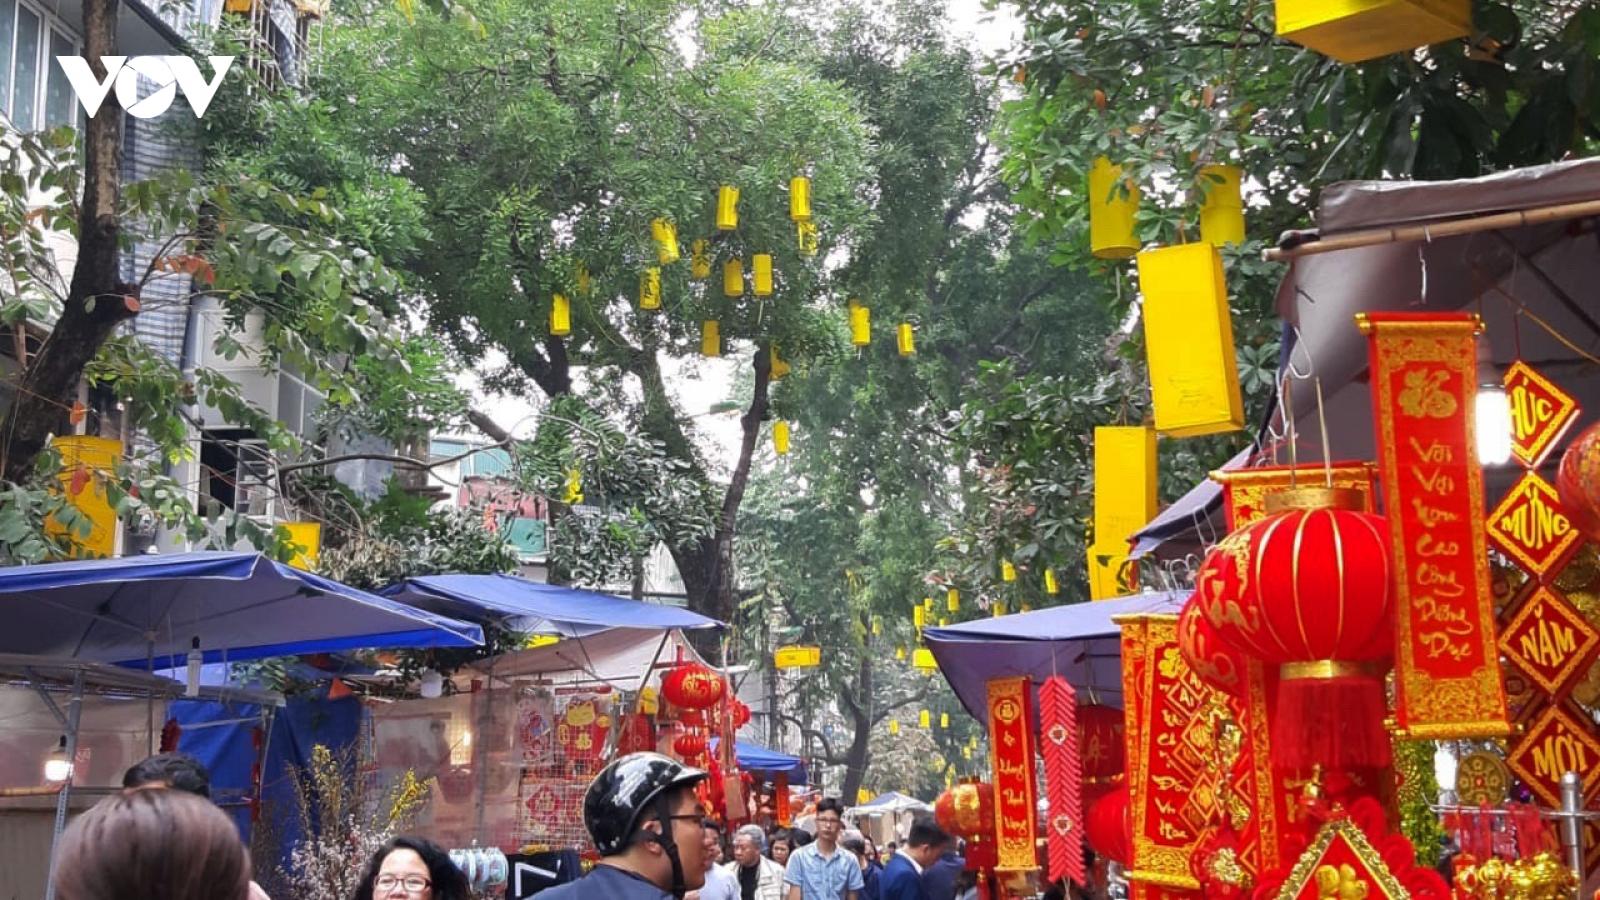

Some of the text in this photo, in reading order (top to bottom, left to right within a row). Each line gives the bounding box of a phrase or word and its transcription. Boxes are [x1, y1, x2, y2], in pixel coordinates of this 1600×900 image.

[1508, 376, 1554, 441] HÚC
[1501, 485, 1571, 550] MỪNG
[1519, 603, 1577, 669] NĂM
[1531, 722, 1589, 784] MỚI
